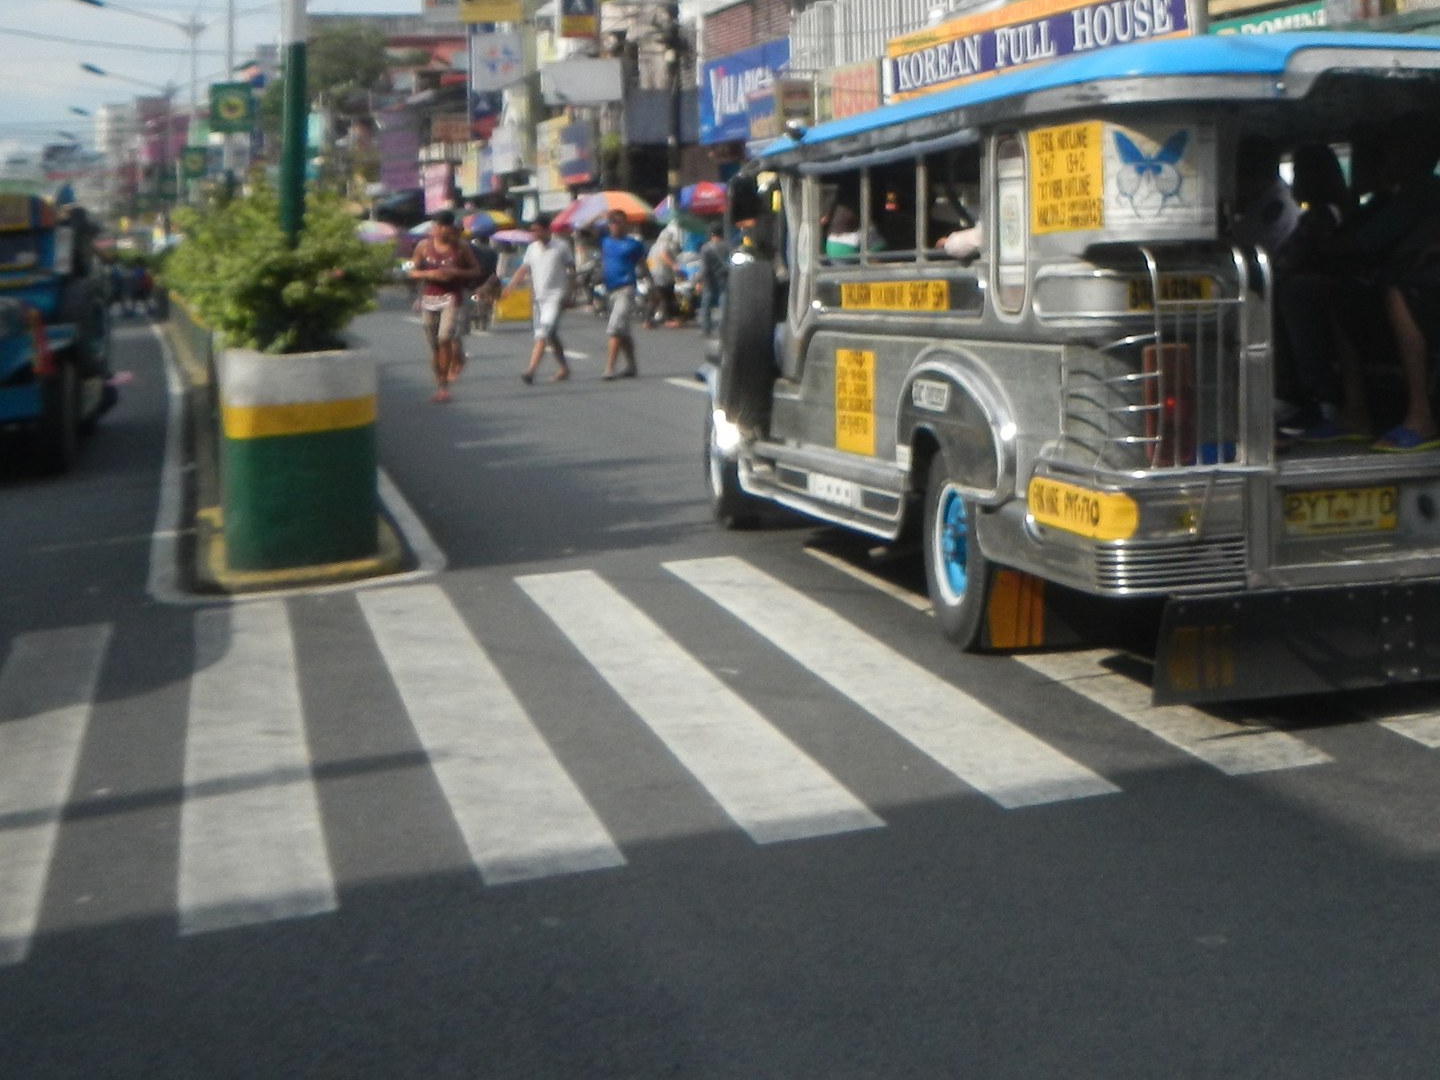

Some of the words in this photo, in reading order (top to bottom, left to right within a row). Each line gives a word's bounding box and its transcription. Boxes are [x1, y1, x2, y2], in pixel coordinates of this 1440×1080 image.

[896, 33, 983, 91] KOREAN
[994, 19, 1057, 68] FULL
[1057, 126, 1088, 151] HOTLINE
[1284, 492, 1338, 519] PYT
